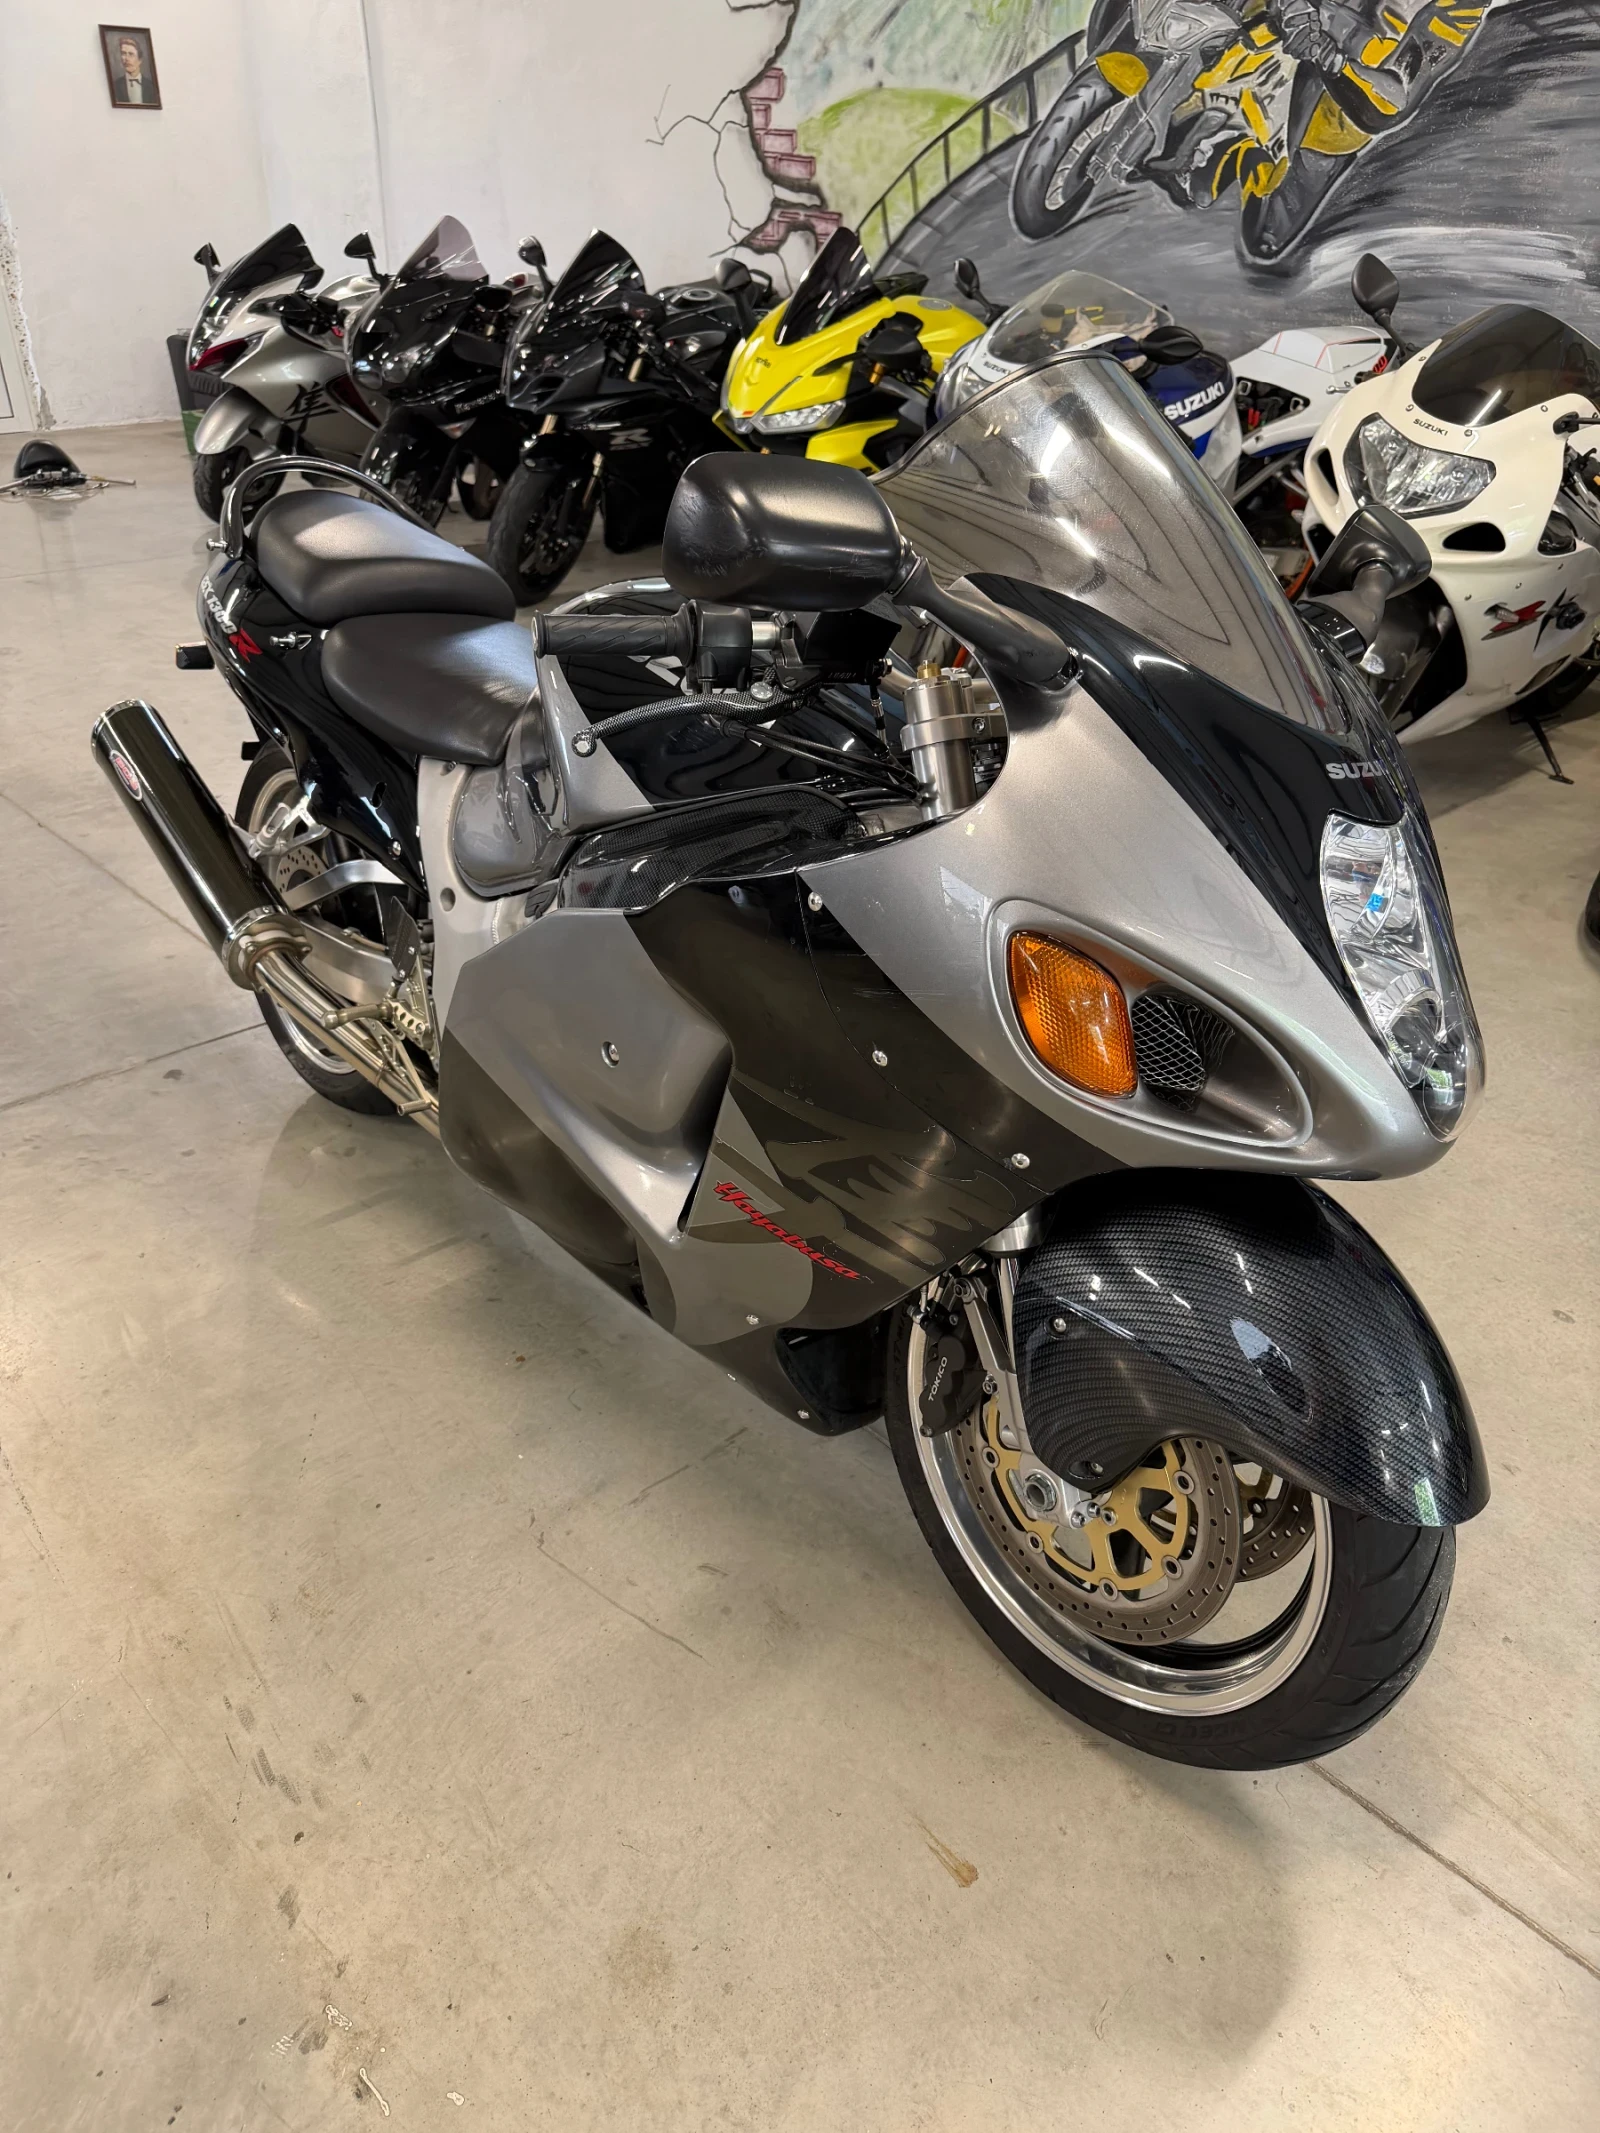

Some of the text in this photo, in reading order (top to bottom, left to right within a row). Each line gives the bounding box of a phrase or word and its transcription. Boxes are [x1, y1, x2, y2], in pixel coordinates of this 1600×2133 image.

[1163, 381, 1226, 421] SUZUKI
[1412, 418, 1449, 437] SUZUKI
[1325, 760, 1385, 780] SUZU
[713, 1180, 861, 1280] Hayabusa
[928, 1356, 948, 1402] TOKICO
